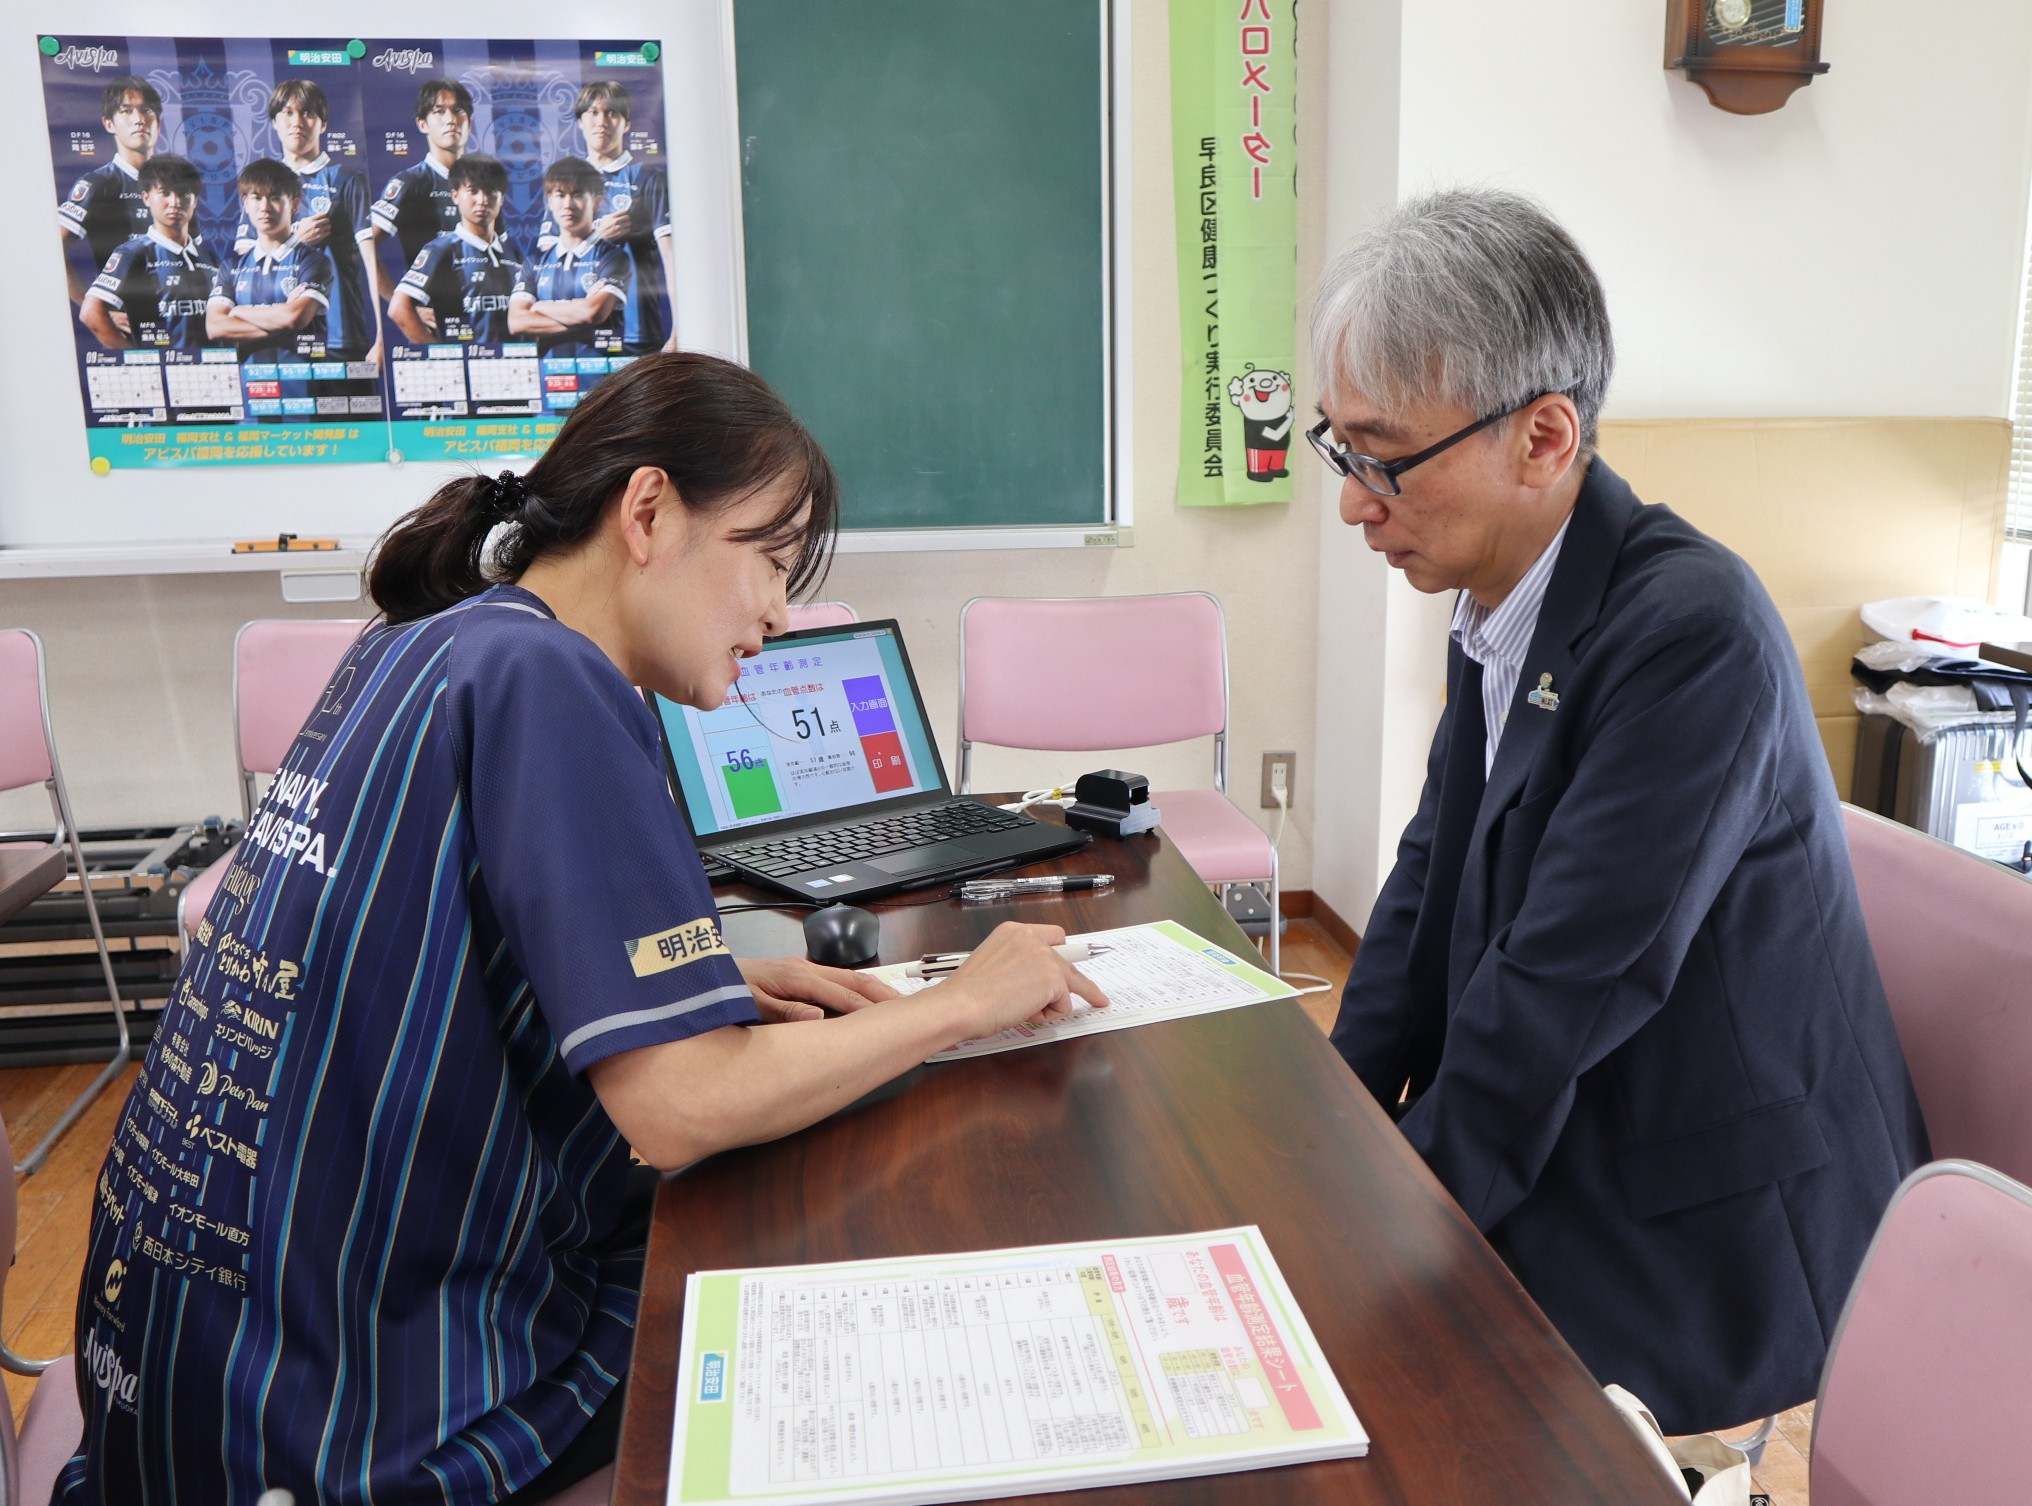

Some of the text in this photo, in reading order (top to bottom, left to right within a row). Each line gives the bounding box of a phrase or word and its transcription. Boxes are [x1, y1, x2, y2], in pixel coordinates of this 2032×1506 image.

[54, 45, 118, 72] Avispa
[300, 52, 343, 64] 明治安田
[372, 48, 433, 75] Avispa
[850, 697, 889, 713] 入力画面
[791, 706, 842, 740] 51 点
[726, 748, 755, 773] 56
[242, 1006, 280, 1040] KIRIN
[201, 1126, 259, 1170] ベスト電器
[168, 1203, 251, 1248] イオンモール直方
[142, 1235, 249, 1292] 西日本シティ銀行
